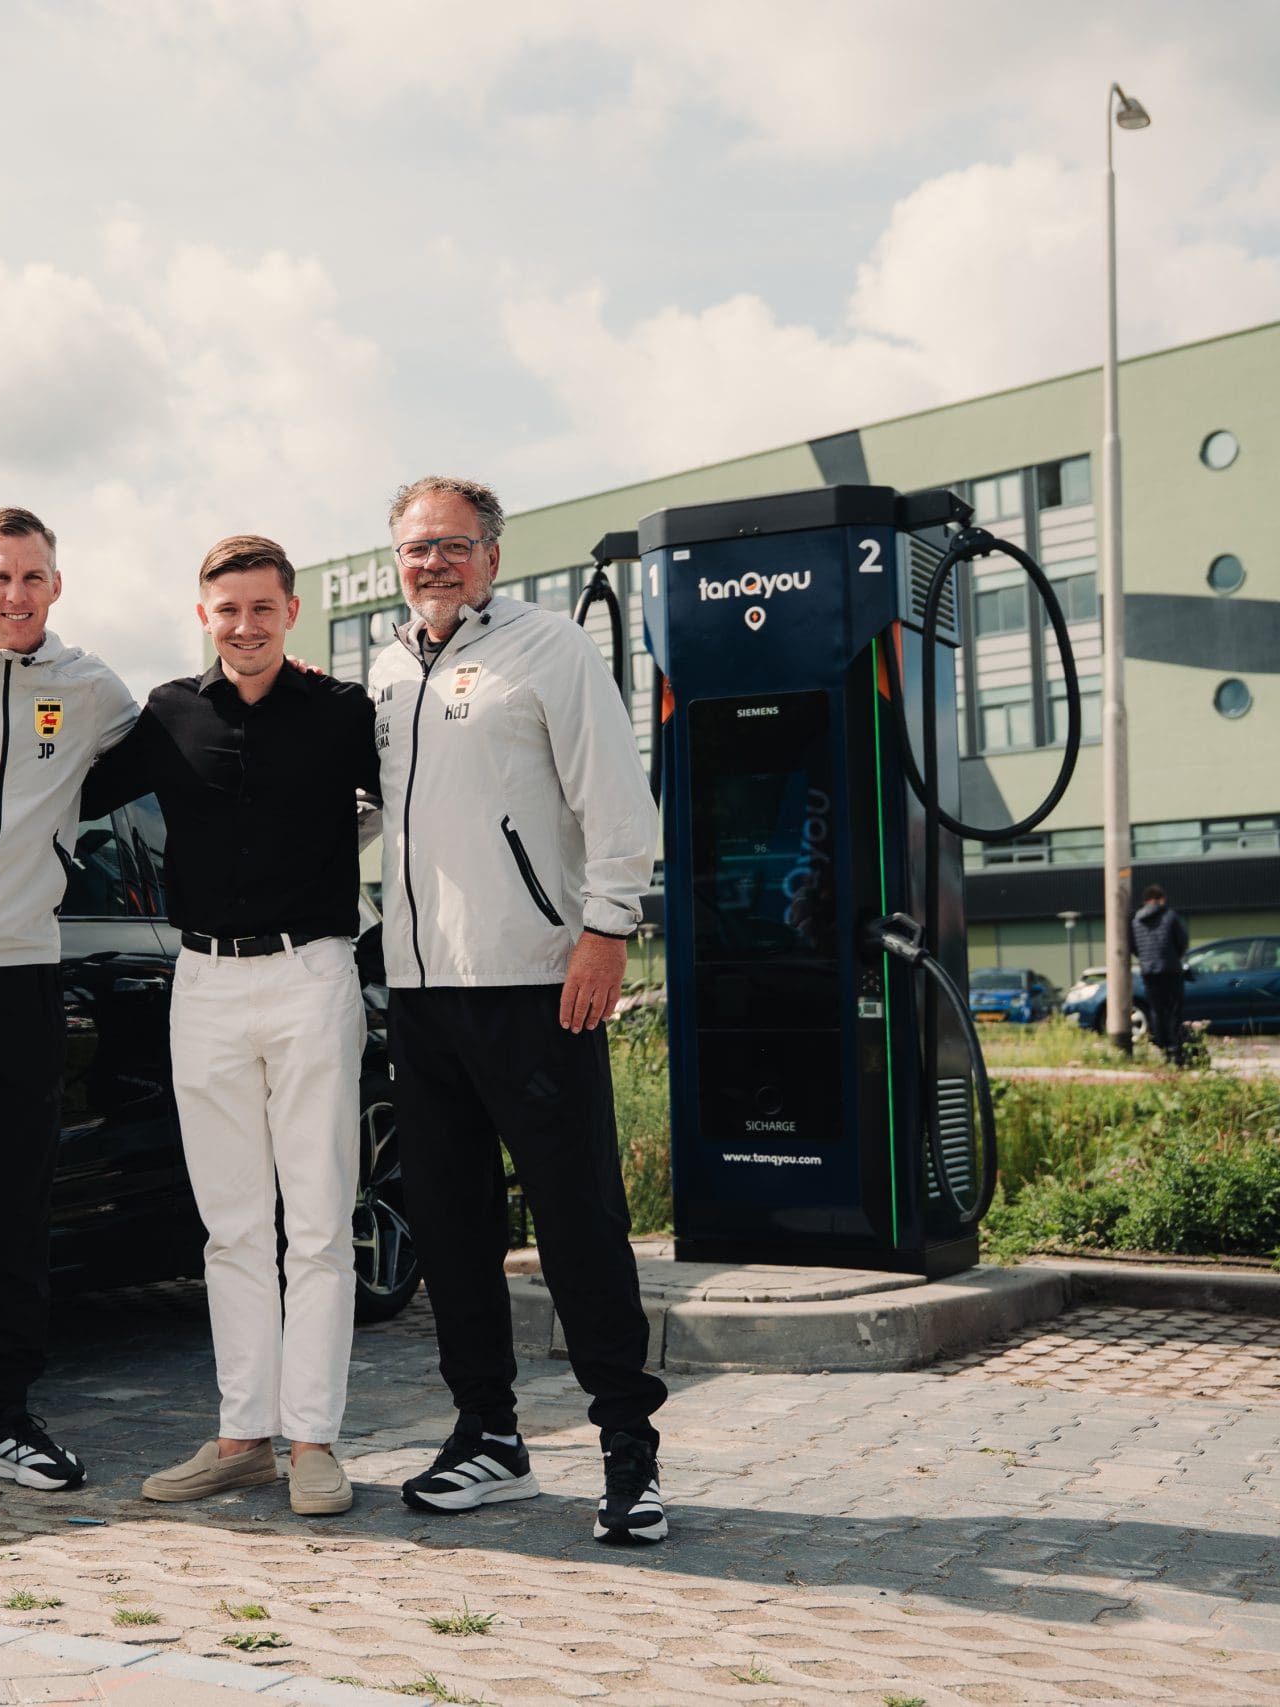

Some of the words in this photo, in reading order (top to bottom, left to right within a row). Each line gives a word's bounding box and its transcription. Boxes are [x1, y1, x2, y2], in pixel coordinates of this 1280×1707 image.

[858, 539, 883, 573] 2
[647, 563, 658, 598] 1
[698, 570, 811, 601] tanQyou
[445, 703, 470, 720] KdJ
[736, 706, 779, 718] SIEMENS
[37, 743, 55, 759] JP
[745, 1120, 797, 1132] SICHARGE
[722, 1152, 822, 1167] www.tanqyou.com
